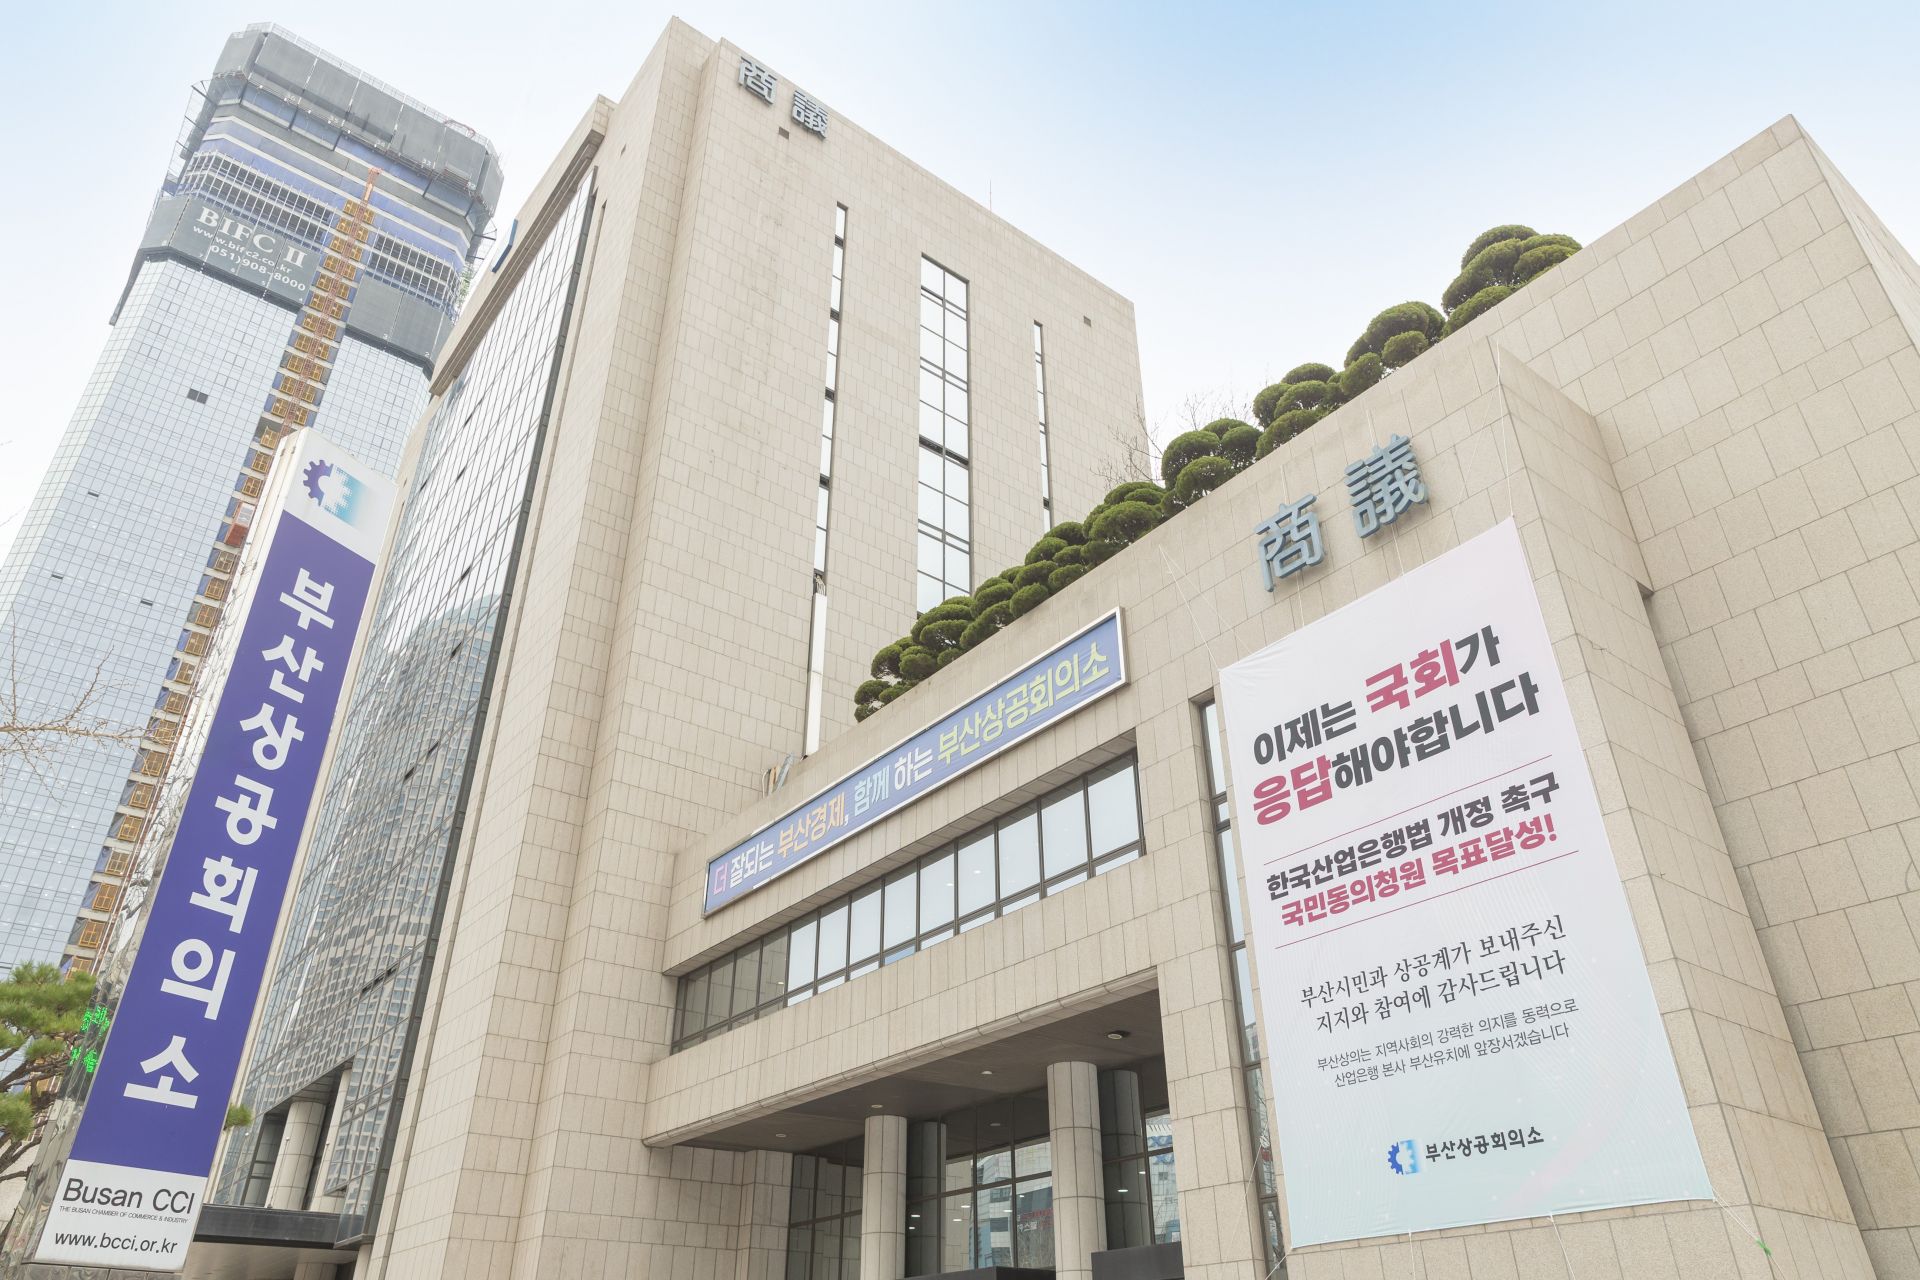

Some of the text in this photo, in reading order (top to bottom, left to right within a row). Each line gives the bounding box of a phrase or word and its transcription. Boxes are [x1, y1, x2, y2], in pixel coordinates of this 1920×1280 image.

[193, 225, 292, 273] www.bifc2.co.kr
[196, 206, 276, 253] BIFC
[1253, 625, 1500, 765] 이제는 국회가
[713, 641, 1109, 895] 더 잘되는 부산경제, 함께 하는 부산상공회의소
[1253, 671, 1540, 826] 응답해야합니다
[123, 567, 335, 1110] 부산상공회의소
[1266, 772, 1560, 900] 한국산업은행법 개정 촉구
[1281, 813, 1558, 926] 국민동의청원 목표달성!
[1300, 914, 1567, 1008] 부산시민과 상공계가 보내주신
[1316, 949, 1566, 1034] 지지와 참여에 감사드립니다
[1317, 998, 1579, 1071] 부산상의는 지역사회의 강력한 의지를 동력으로
[1334, 1021, 1569, 1088] 산업은행 본사 부산유치에 앞장서겠습니다
[1425, 1126, 1544, 1162] 부산상공회의소
[62, 1177, 195, 1214] Busan CCI
[55, 1232, 178, 1254] www.bcci.or.kr
